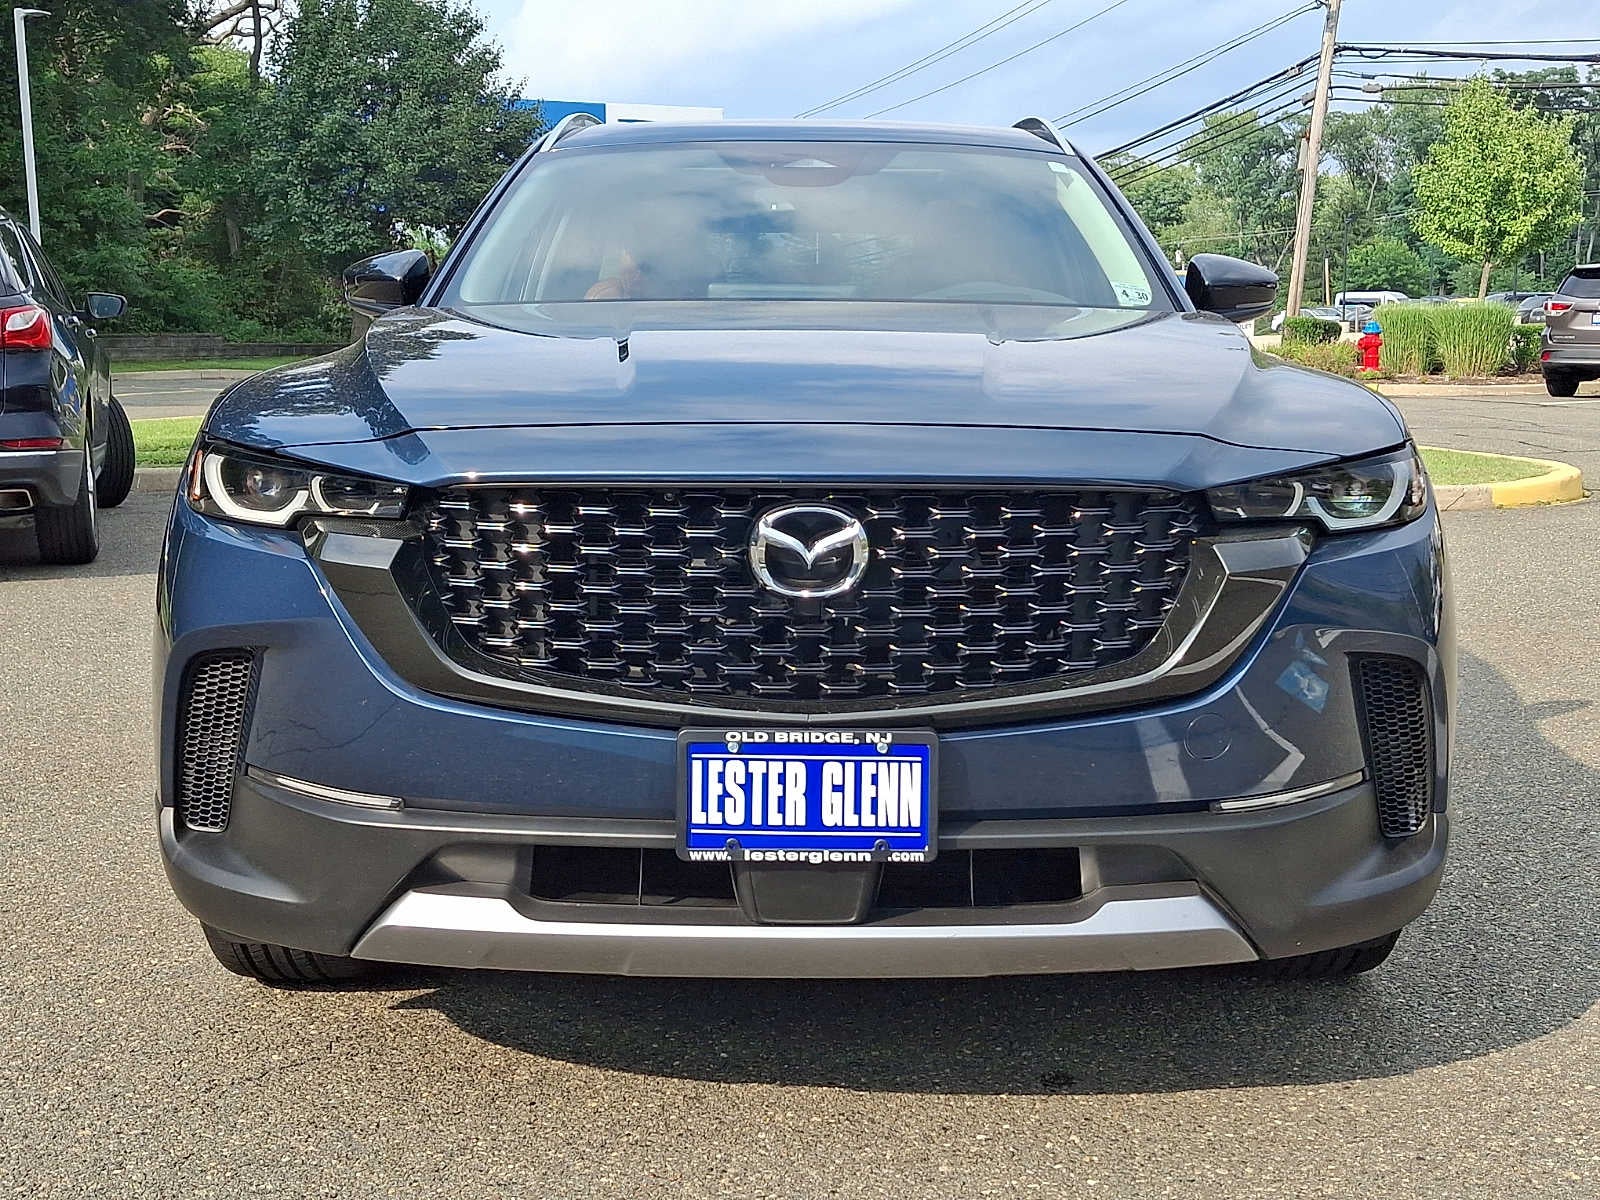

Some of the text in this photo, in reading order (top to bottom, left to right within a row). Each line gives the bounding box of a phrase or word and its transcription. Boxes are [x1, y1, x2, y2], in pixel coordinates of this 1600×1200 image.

[725, 731, 893, 745] OLD BRIDGE, NJ
[691, 759, 922, 828] LESTER GLENN
